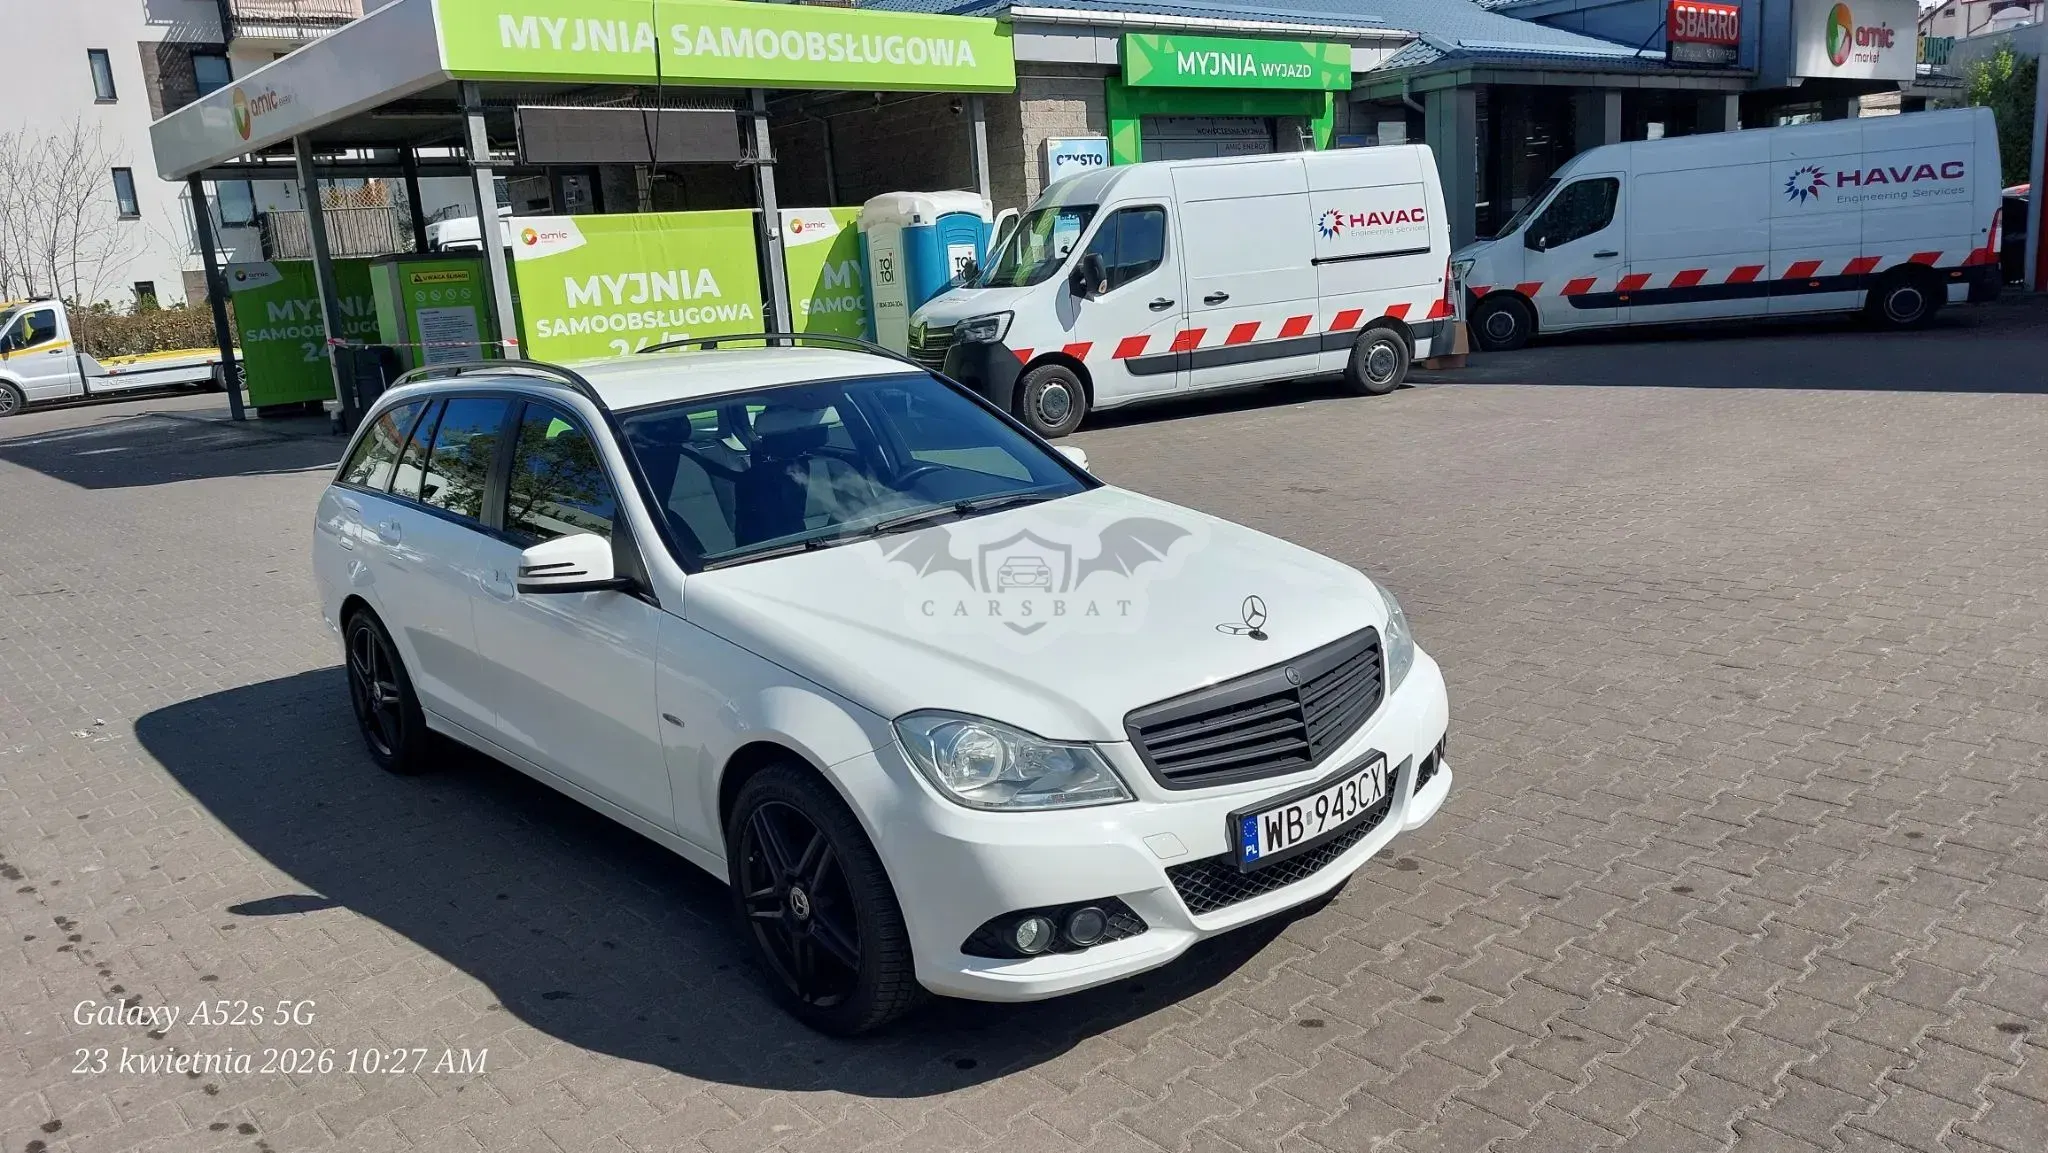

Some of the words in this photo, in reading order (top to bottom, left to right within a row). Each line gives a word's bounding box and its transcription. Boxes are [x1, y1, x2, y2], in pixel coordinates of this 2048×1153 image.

[1675, 6, 1738, 40] SBARRO
[498, 14, 656, 53] MYJNIA
[671, 24, 976, 67] SAMOOBSŁUGOWA
[1855, 22, 1895, 48] amic
[1177, 51, 1257, 76] MYJNIA
[1261, 63, 1312, 78] WYJAZD
[1854, 52, 1880, 63] market
[251, 86, 278, 116] amic
[1056, 154, 1103, 166] CZYSTO
[1837, 161, 1964, 188] HAVAC
[1837, 190, 1908, 204] Engineering
[1912, 186, 1965, 198] Services
[804, 220, 826, 229] amic
[1349, 208, 1425, 228] HAVAC
[540, 230, 568, 240] amic
[1351, 227, 1394, 237] Engineering
[1396, 224, 1426, 233] Services
[955, 257, 972, 269] TO
[564, 268, 721, 309] MYJNIA
[536, 303, 754, 338] SAMOOBSŁUGOWA
[1265, 806, 1304, 852] WB
[1315, 764, 1382, 833] 943CX
[1245, 845, 1257, 856] PL
